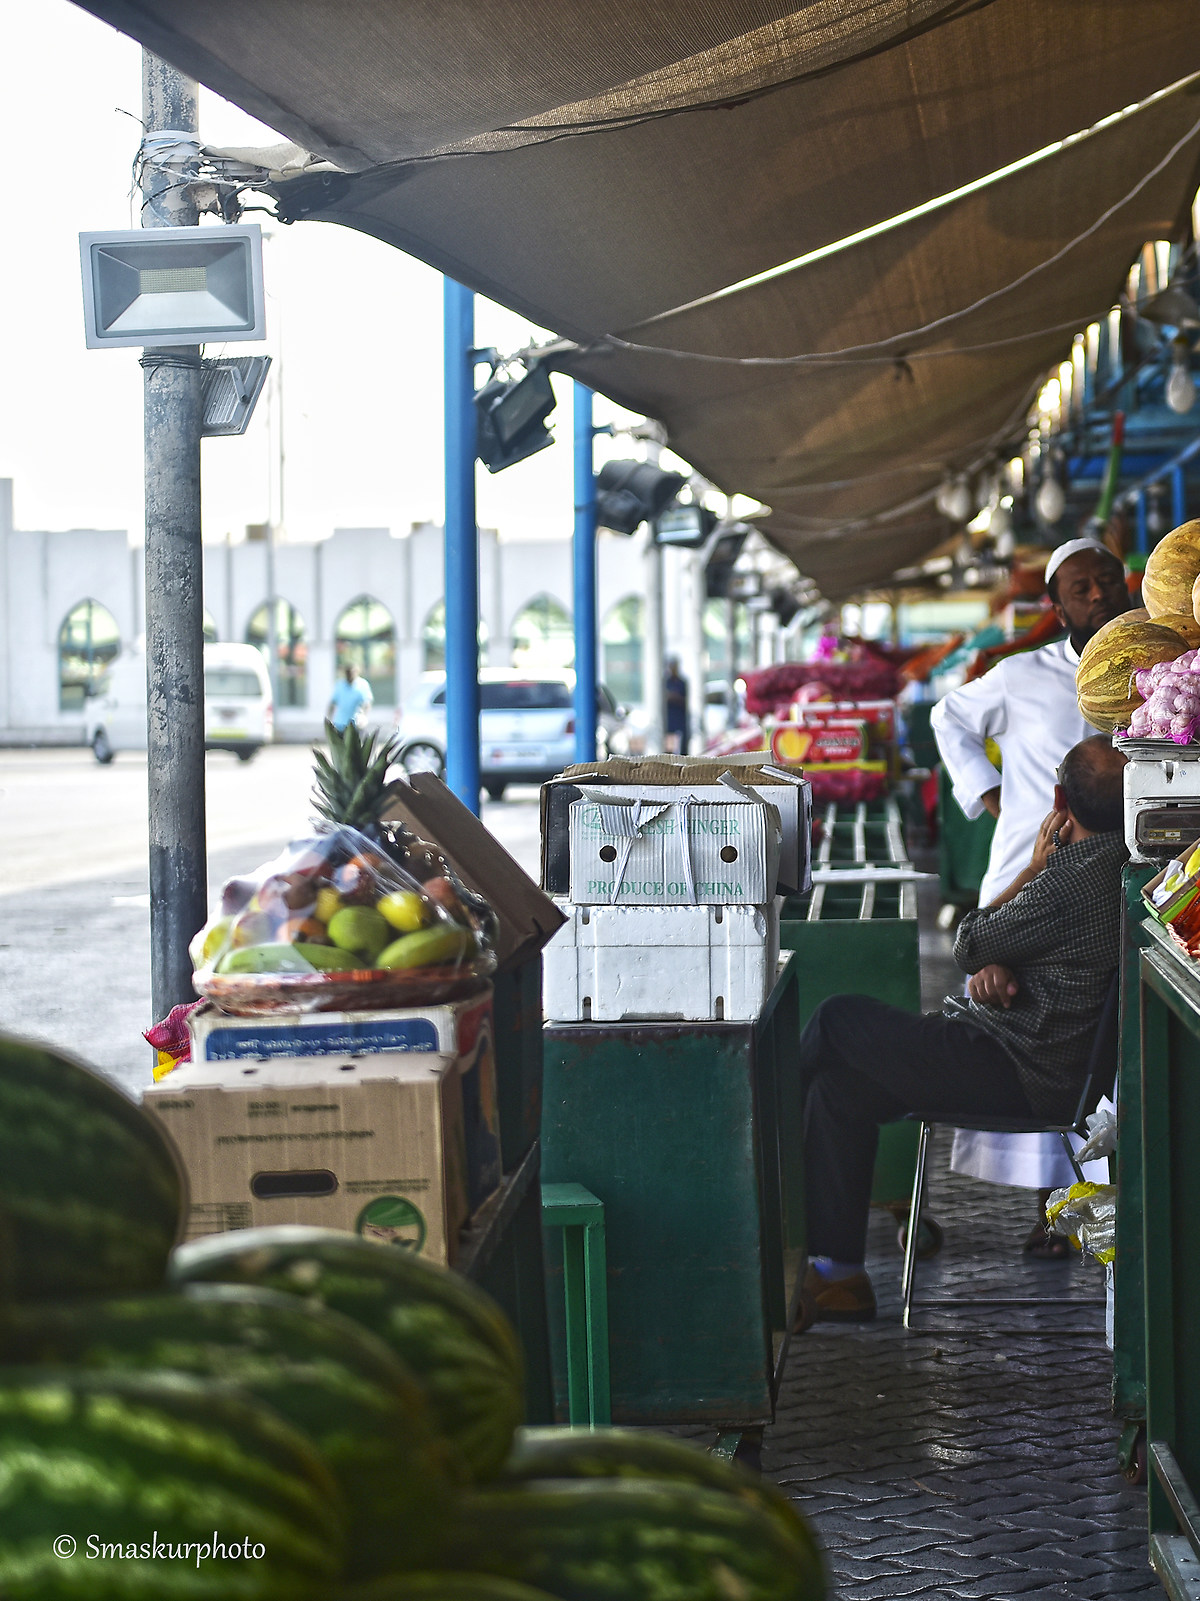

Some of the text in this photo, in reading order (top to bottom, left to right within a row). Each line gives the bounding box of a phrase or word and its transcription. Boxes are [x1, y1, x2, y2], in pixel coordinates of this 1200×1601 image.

[587, 880, 744, 896] PRODUCE OF CHINA
